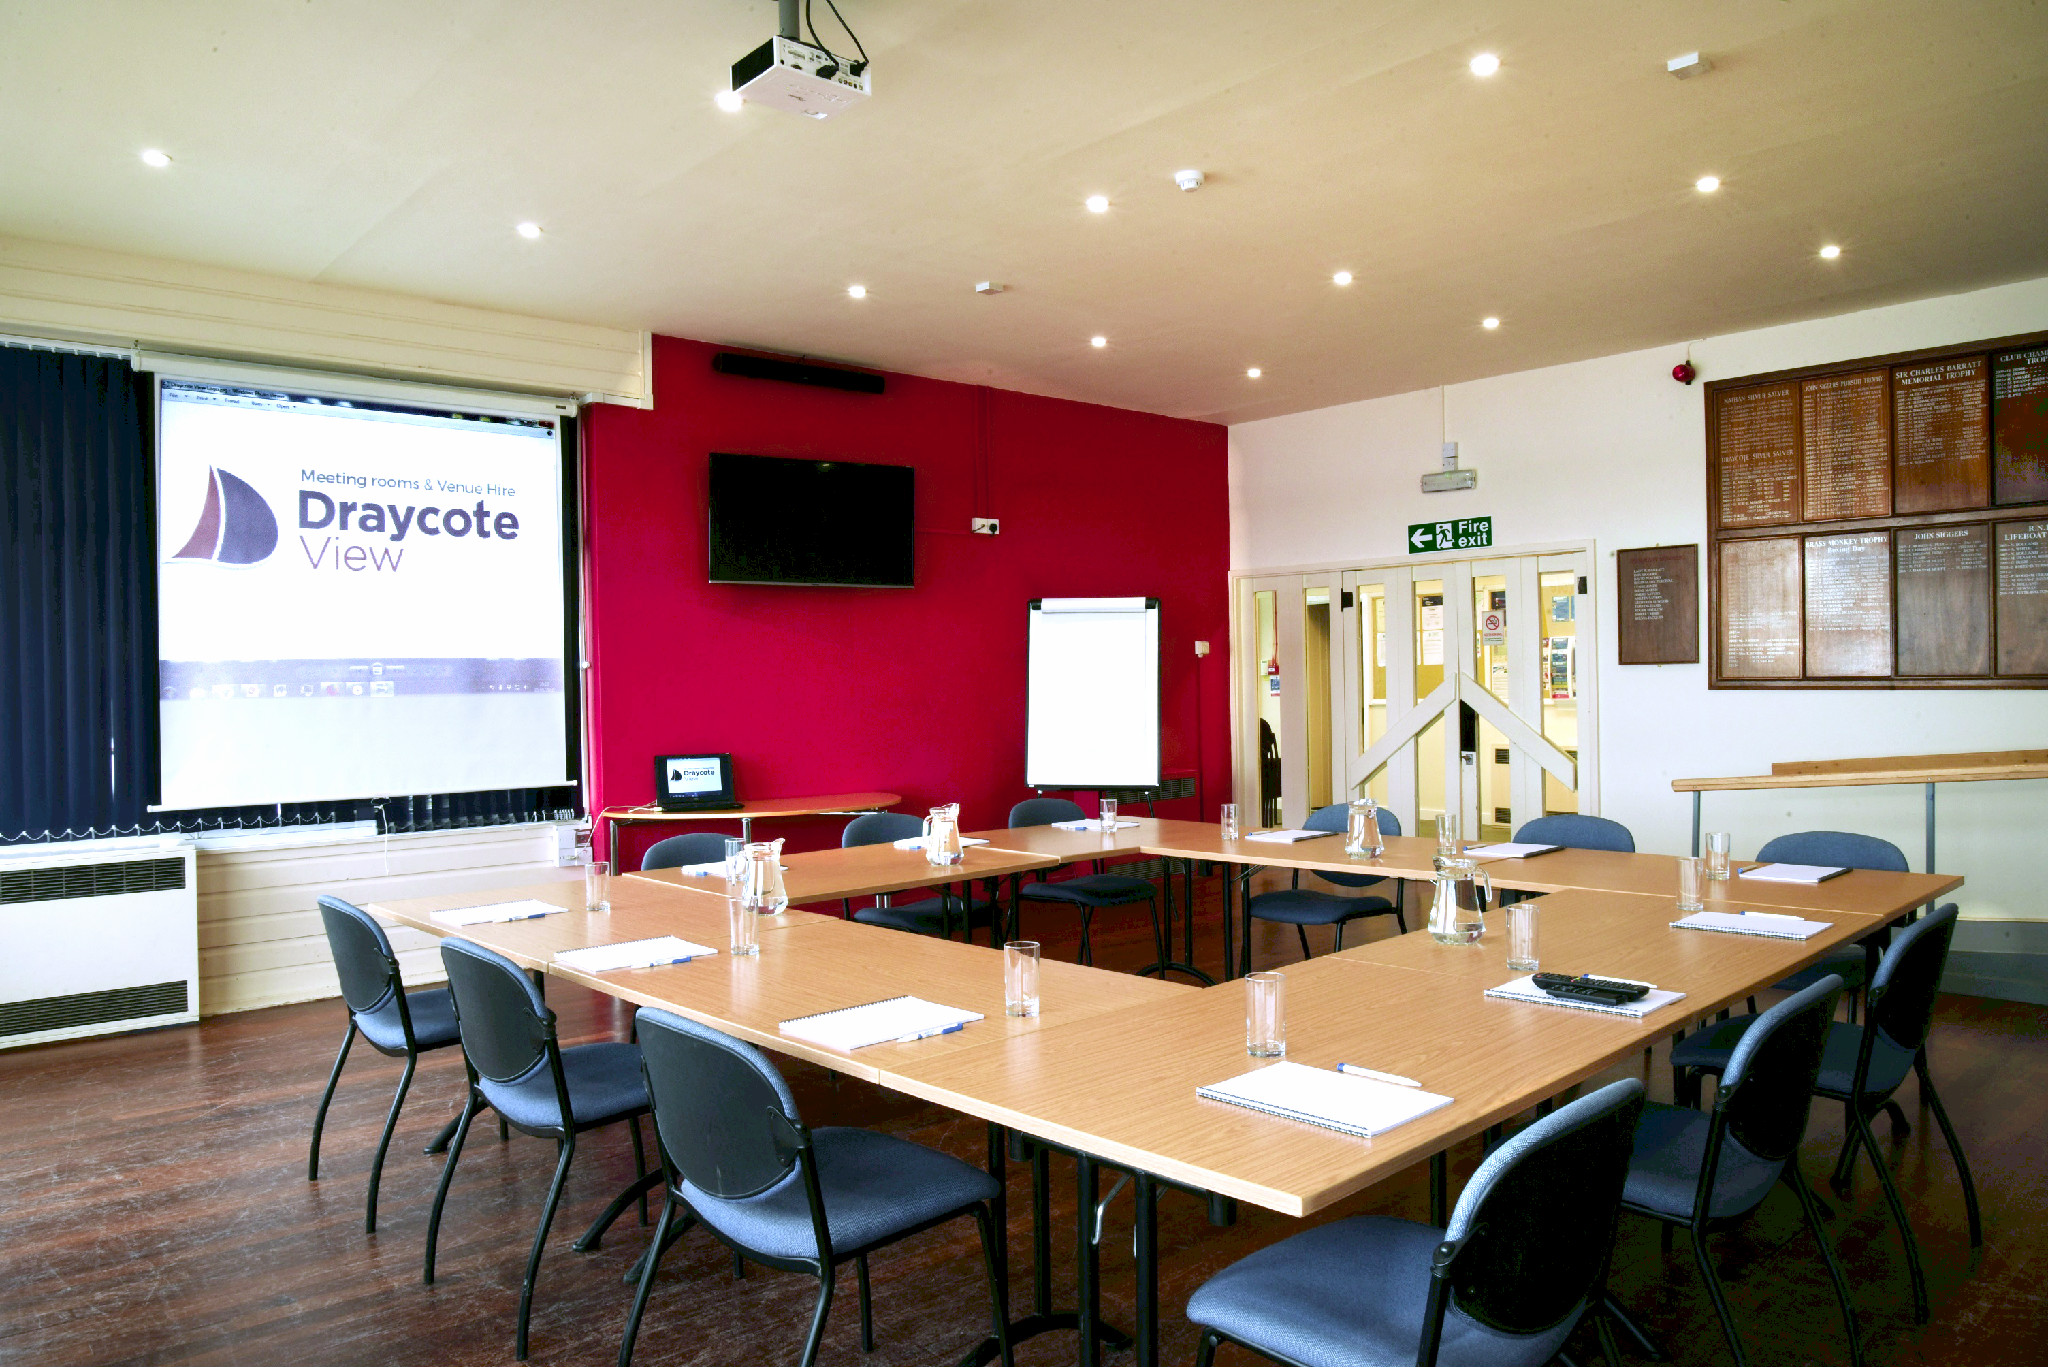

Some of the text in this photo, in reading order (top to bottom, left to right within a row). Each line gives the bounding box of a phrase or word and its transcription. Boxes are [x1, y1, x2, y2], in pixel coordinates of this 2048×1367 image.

[2000, 348, 2048, 362] CLUB CHAM
[1895, 360, 1982, 379] SIR CHARLES BARRATT
[1901, 369, 1976, 386] MEMORIAL TROPHY
[301, 469, 516, 496] Meeting rooms & Venue Hire
[299, 489, 519, 542] Draycote
[1458, 519, 1489, 534] Fire
[1458, 532, 1488, 547] exit
[1805, 536, 1888, 548] BRASS MONKEY TROPHY
[1914, 529, 1969, 540] JOHN SIGGERS
[2004, 531, 2047, 541] LIFEBOAT
[299, 535, 404, 572] View
